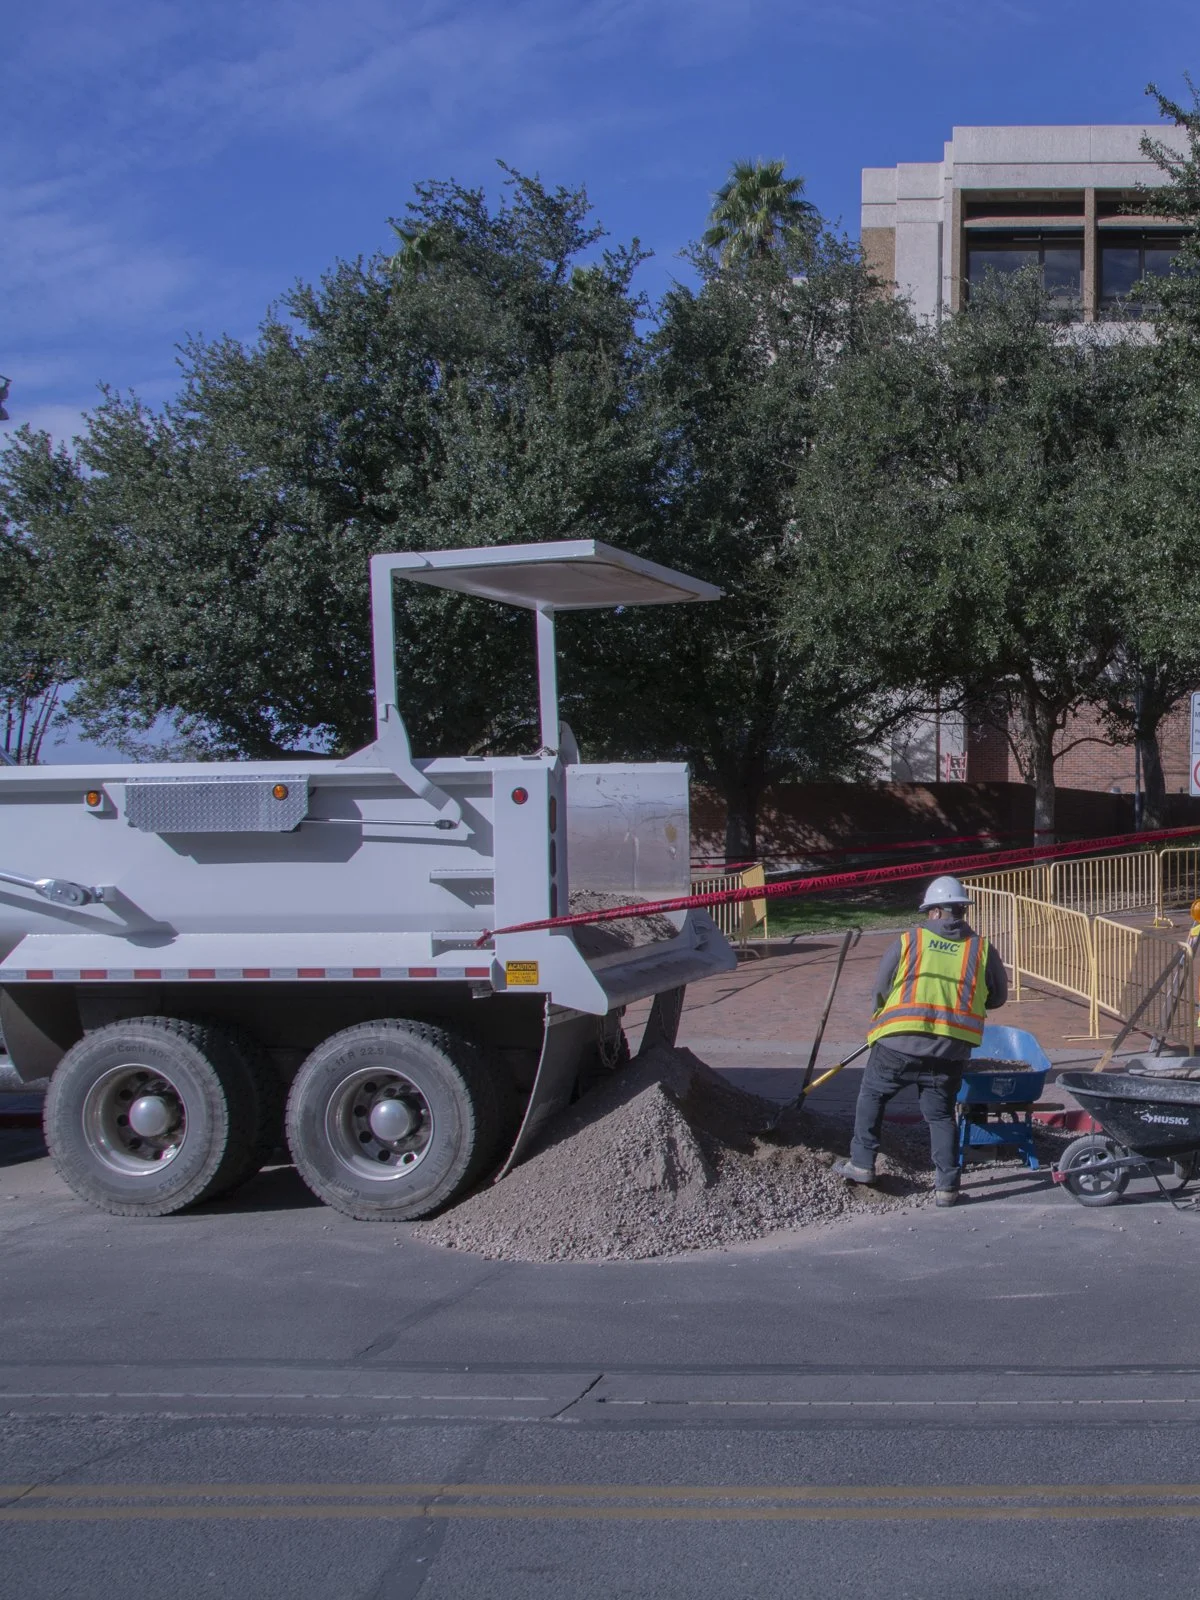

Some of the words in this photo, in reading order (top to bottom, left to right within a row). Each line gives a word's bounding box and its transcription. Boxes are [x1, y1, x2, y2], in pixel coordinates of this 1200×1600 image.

[928, 939, 961, 952] NWC
[359, 1047, 385, 1057] 22.5
[1153, 1115, 1189, 1125] HUSKY
